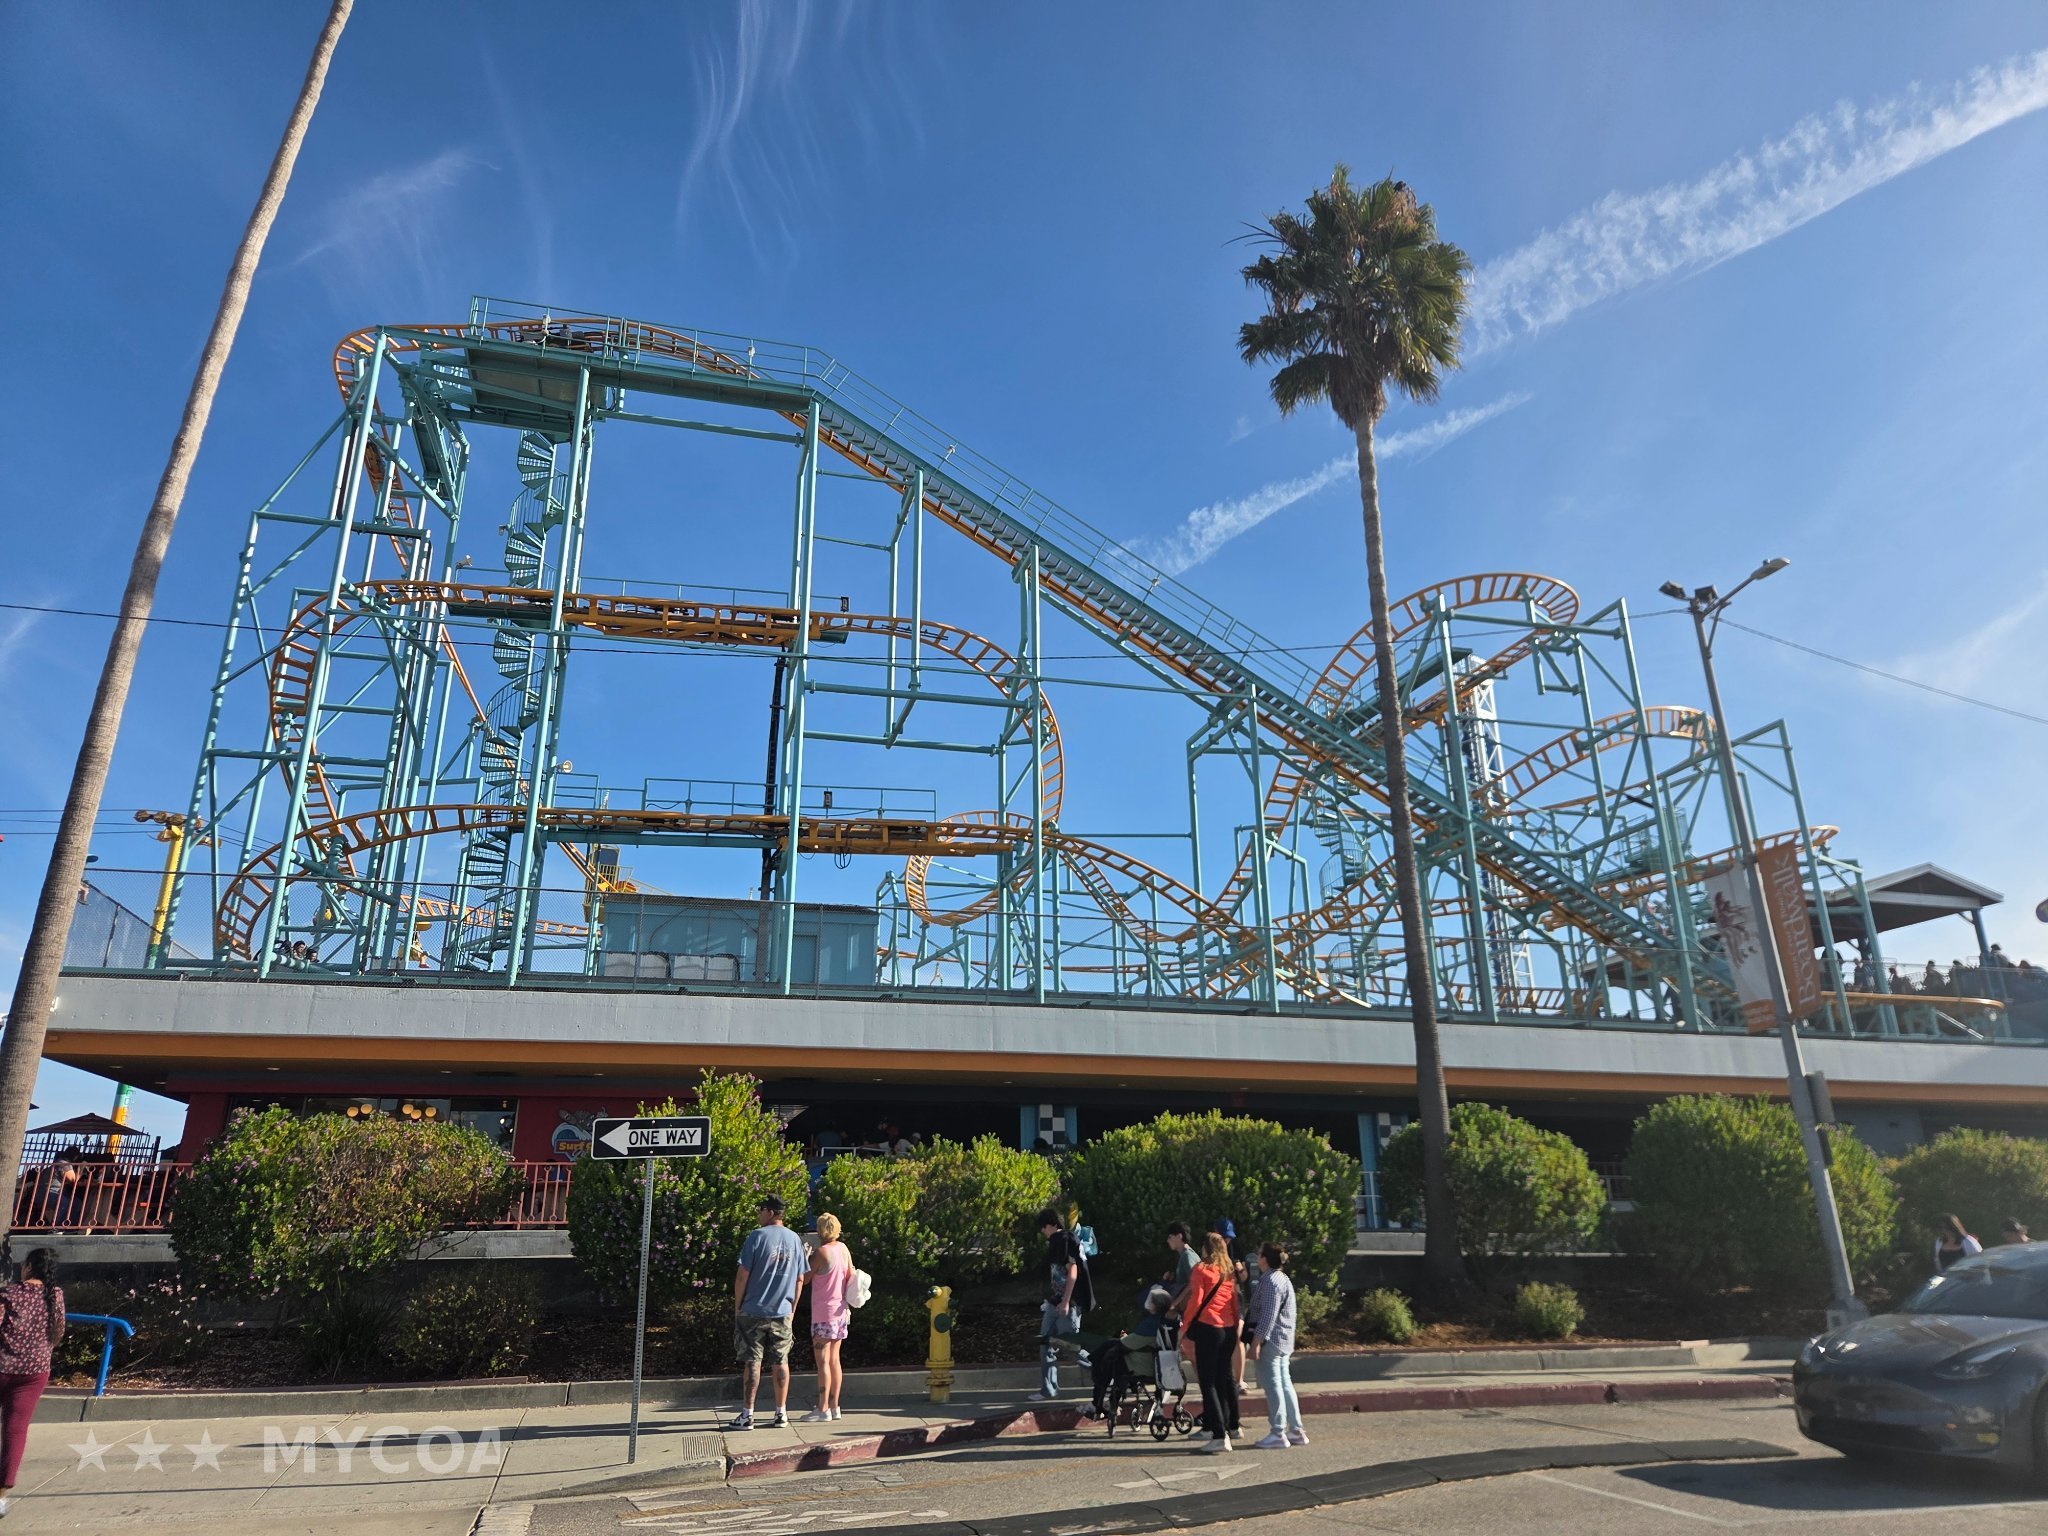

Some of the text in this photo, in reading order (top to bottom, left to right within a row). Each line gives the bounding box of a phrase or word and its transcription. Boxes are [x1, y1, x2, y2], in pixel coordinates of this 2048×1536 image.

[1772, 853, 1816, 1004] Boardwalk
[559, 1141, 585, 1151] Surf
[628, 1129, 698, 1146] ONE WAY
